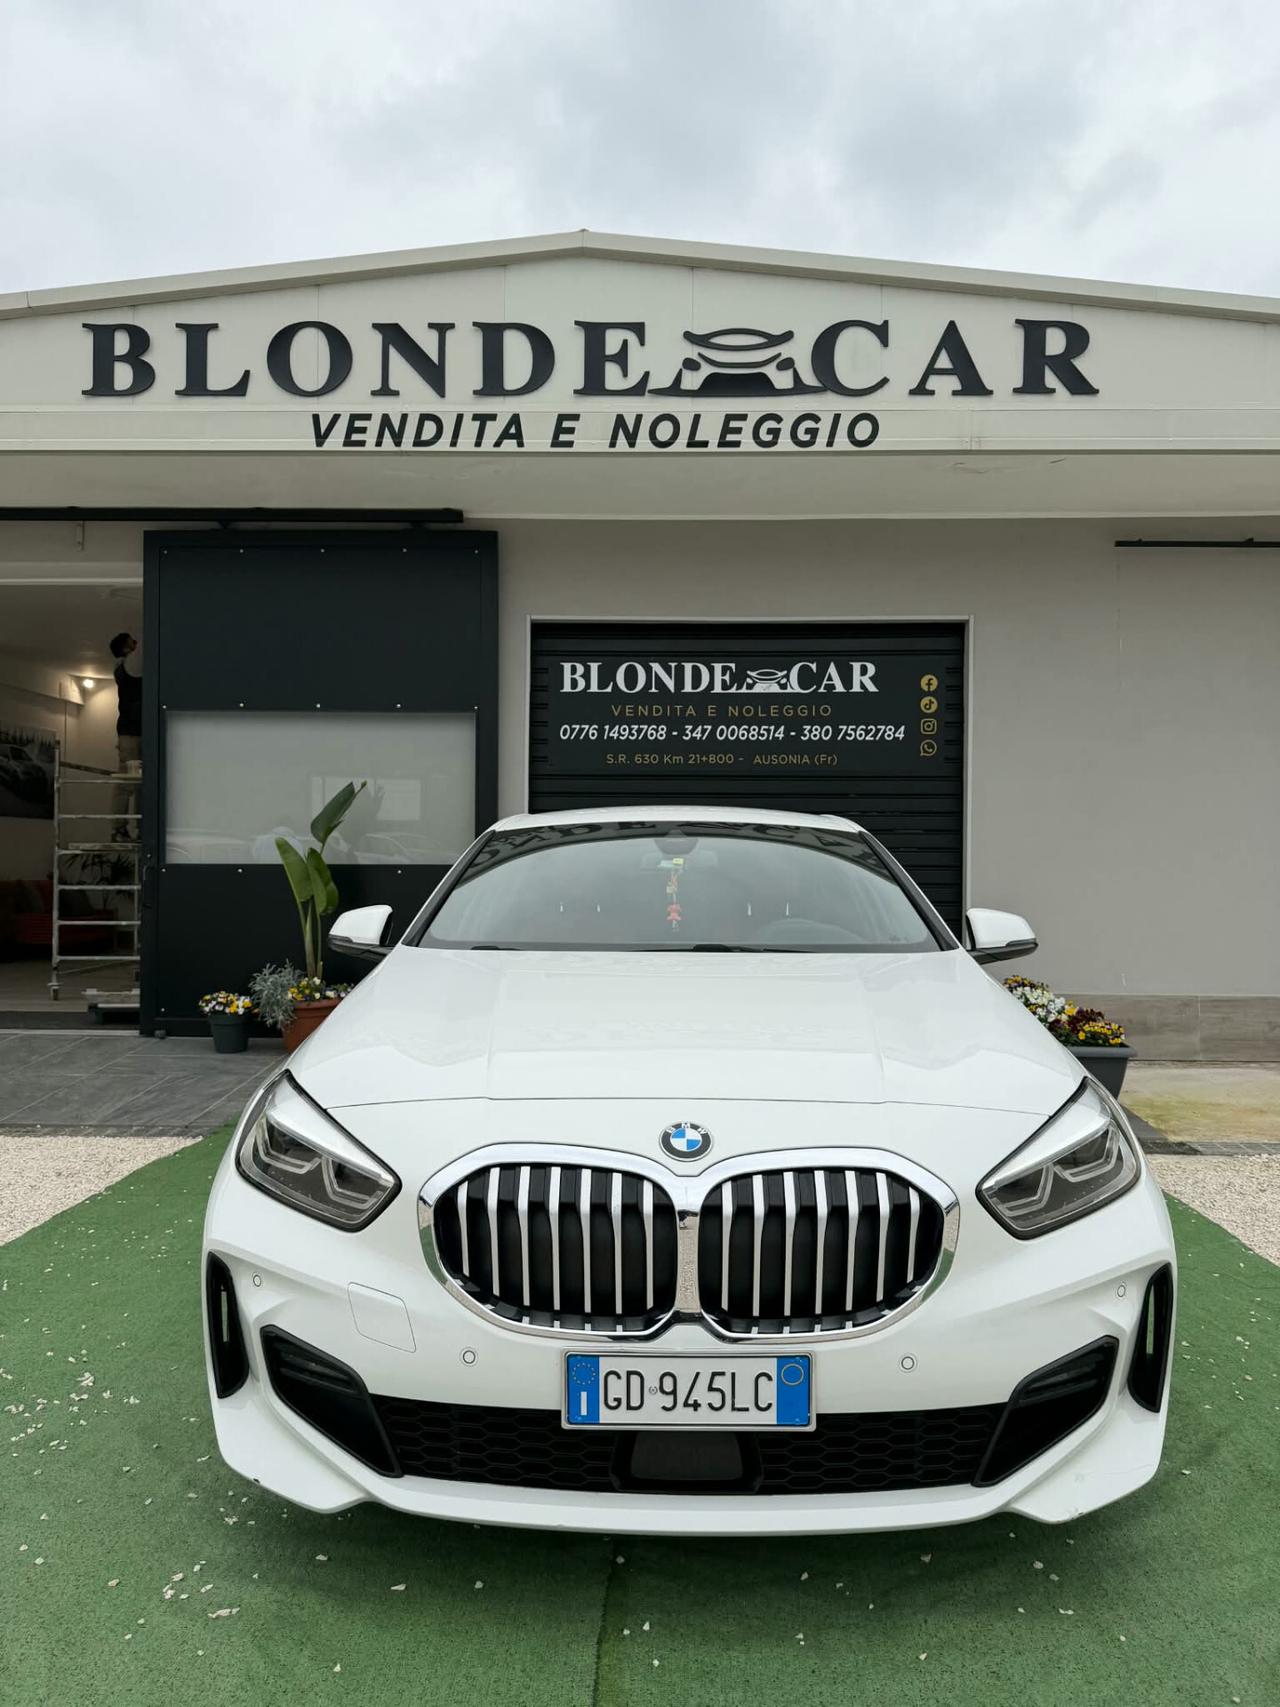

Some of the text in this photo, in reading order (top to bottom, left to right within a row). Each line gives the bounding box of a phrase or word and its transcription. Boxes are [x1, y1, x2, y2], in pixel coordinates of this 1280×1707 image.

[82, 318, 1100, 398] BLONDE CAR
[311, 412, 880, 449] VENDITA E NOLEGGIO
[559, 661, 880, 694] BLONDE CAR
[611, 704, 832, 717] VENDITA E NOLEGGIO
[559, 724, 599, 741] 0776
[603, 724, 667, 741] 1493768
[682, 724, 712, 741] 347
[716, 724, 785, 741] 0068514
[800, 724, 833, 741] 380
[837, 724, 906, 741] 7562784
[606, 753, 631, 765] S.R.
[634, 753, 659, 765] 630
[663, 753, 684, 765] Km
[687, 753, 735, 765] 21+800
[753, 754, 810, 765] AUSONIA
[814, 753, 839, 766] (Fr)
